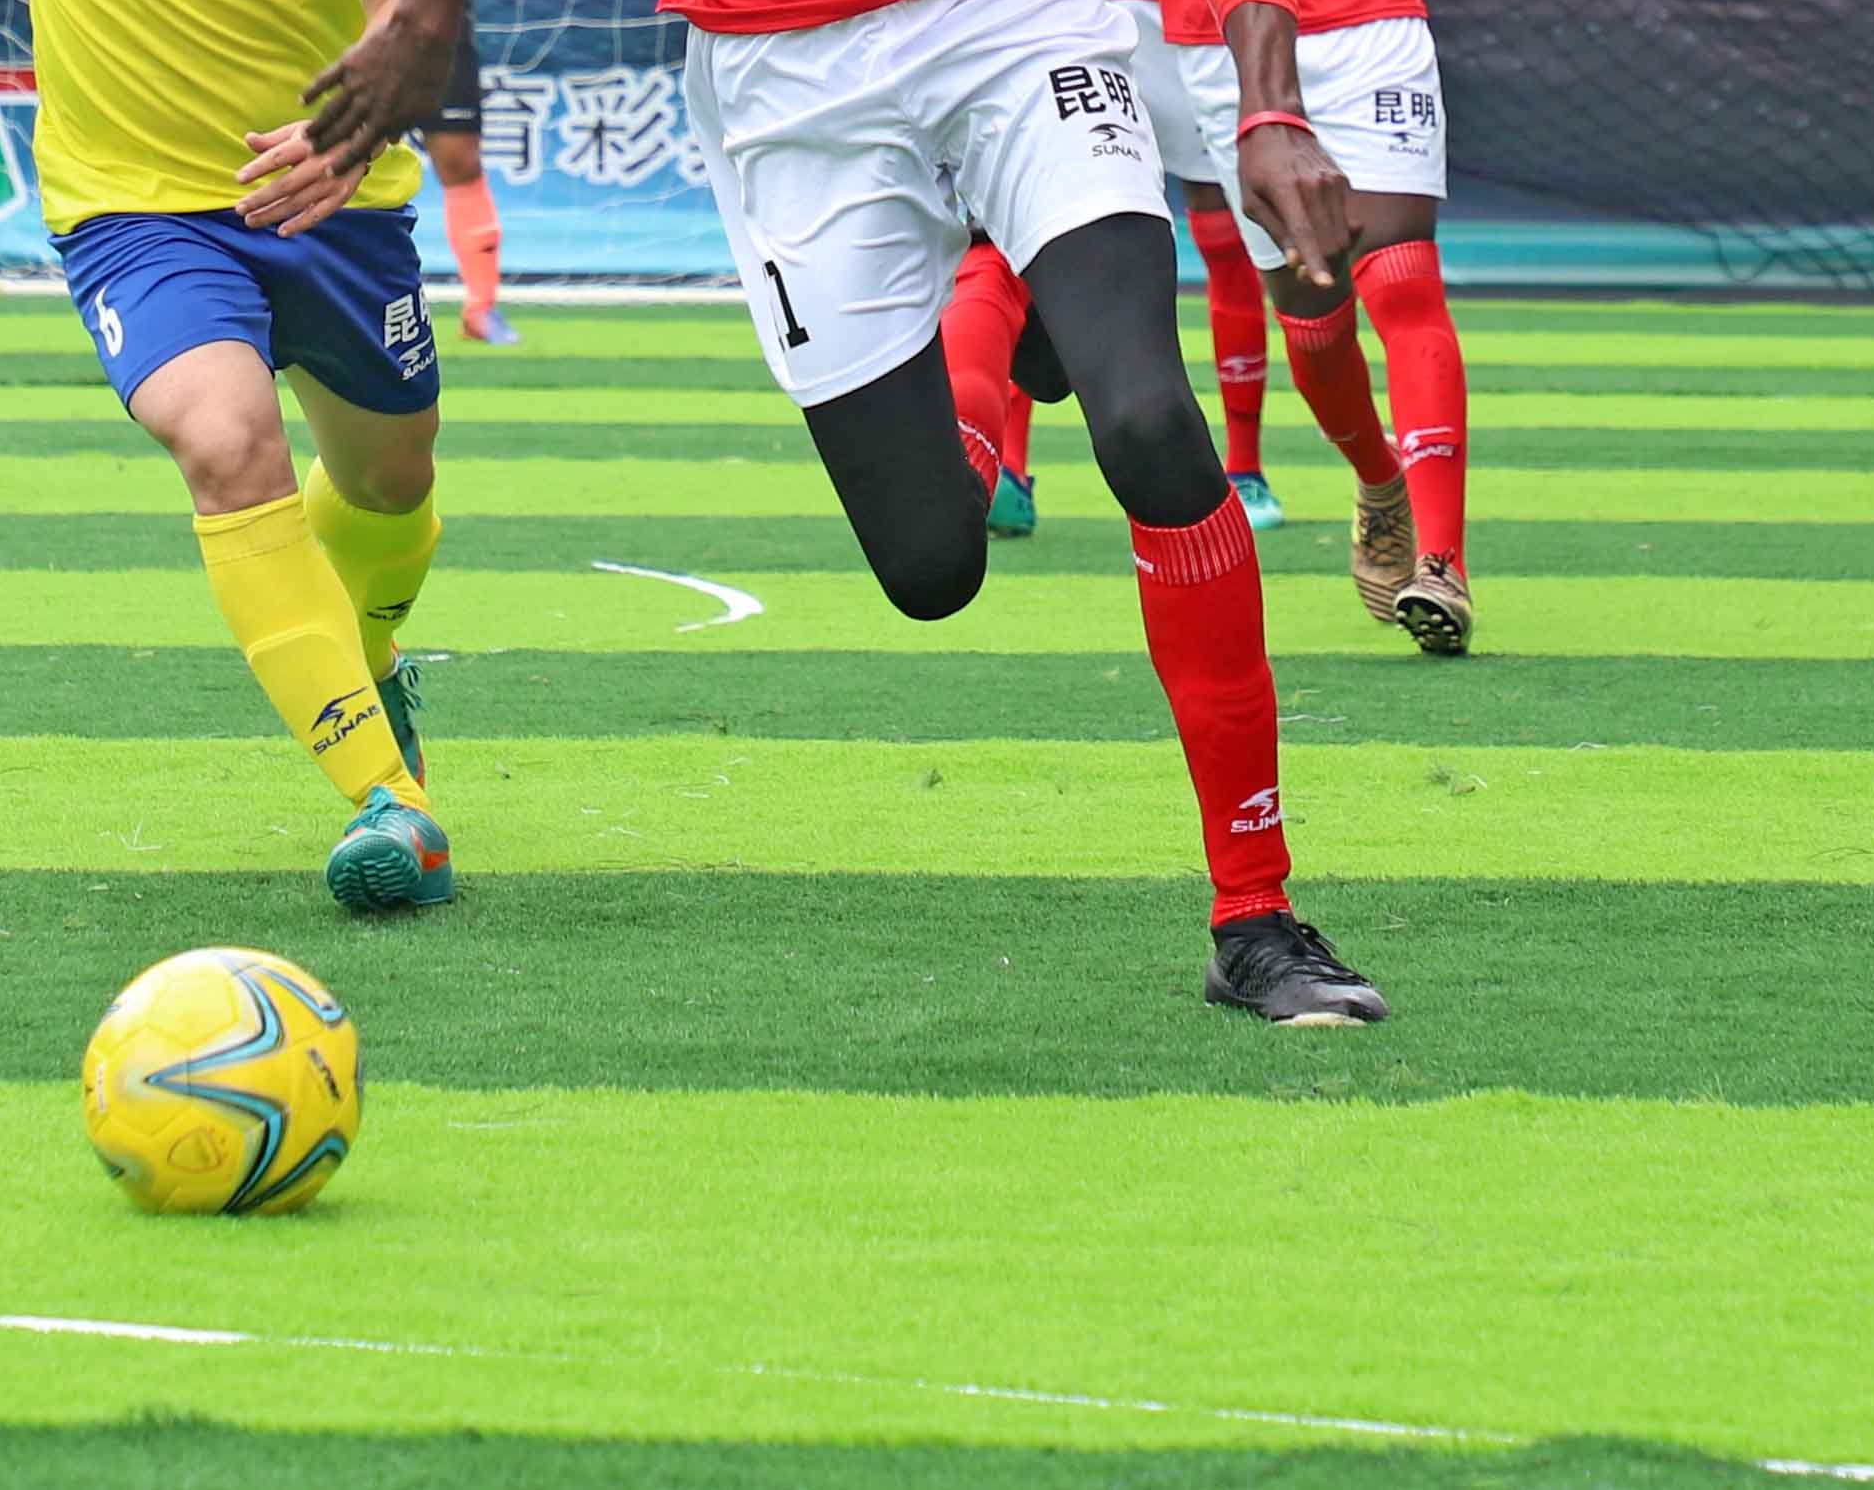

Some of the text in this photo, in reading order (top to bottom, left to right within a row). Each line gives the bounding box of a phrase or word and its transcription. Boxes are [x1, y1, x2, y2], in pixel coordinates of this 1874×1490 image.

[1048, 65, 1139, 124] 昆明
[1374, 90, 1437, 127] 昆明
[479, 63, 709, 186] 育彩
[313, 704, 382, 755] SUNAIS
